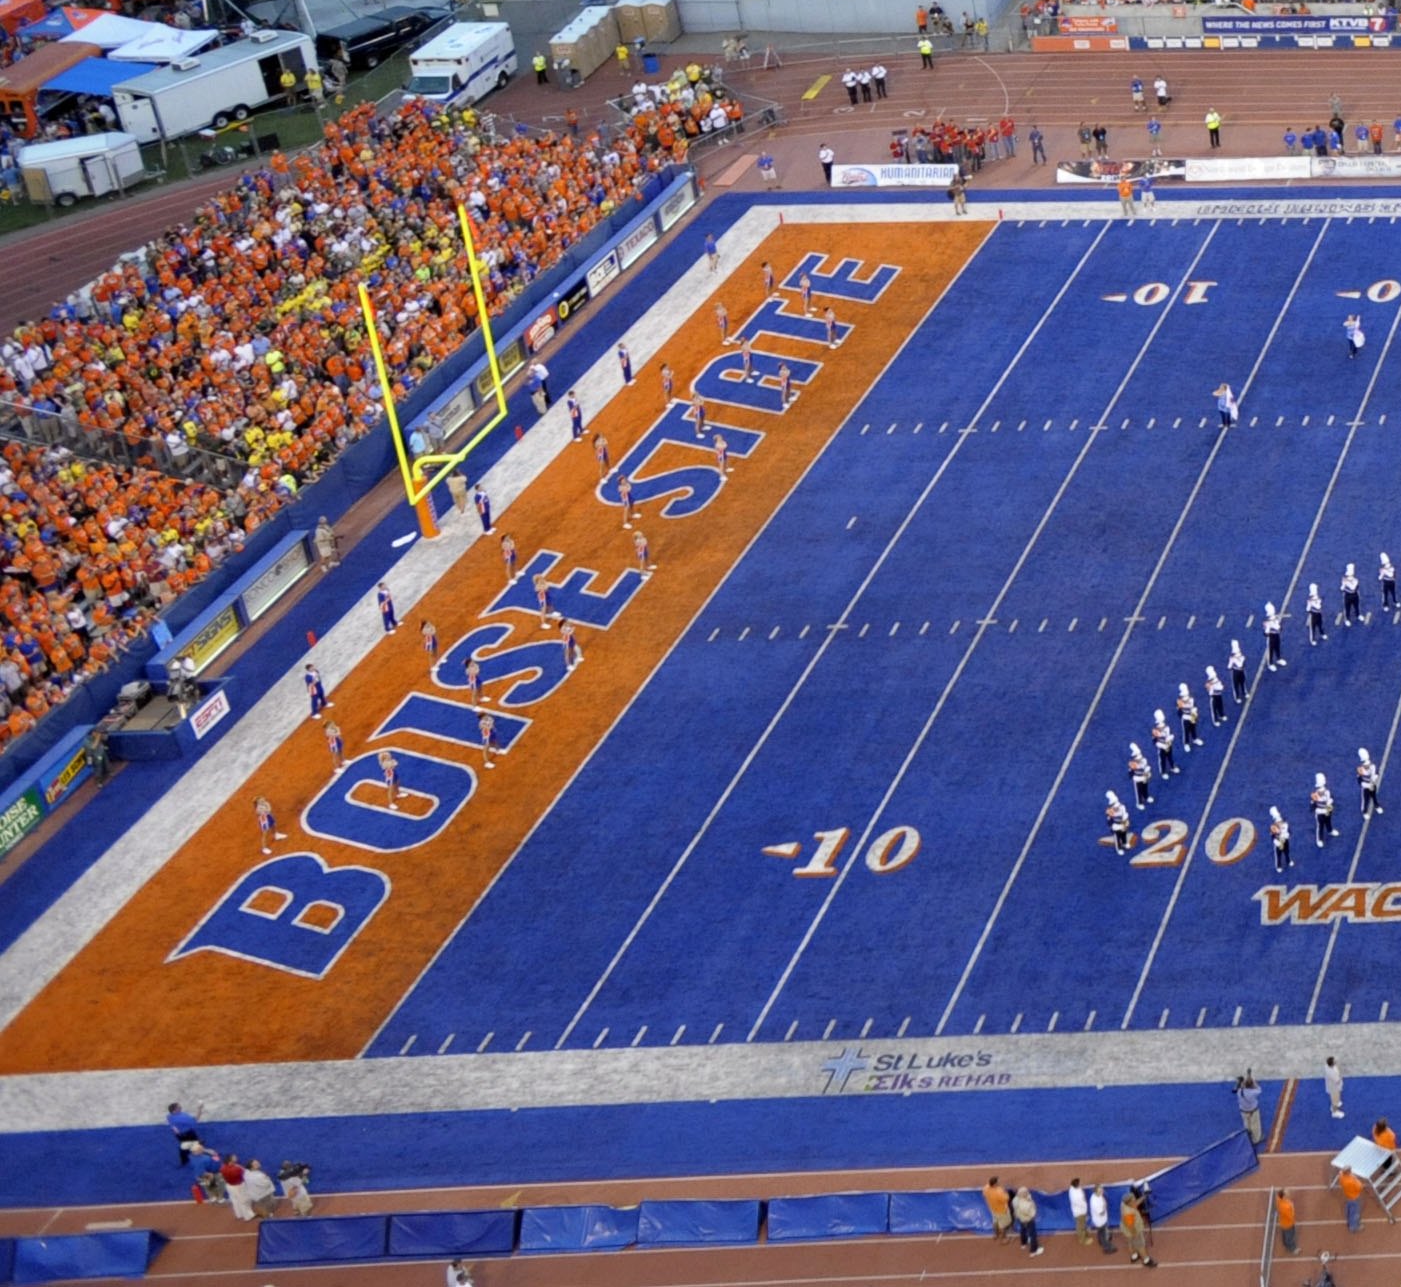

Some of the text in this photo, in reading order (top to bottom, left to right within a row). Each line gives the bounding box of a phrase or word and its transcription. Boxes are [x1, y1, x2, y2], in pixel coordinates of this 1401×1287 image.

[1206, 18, 1383, 31] WHERE THE NEWS COMES FIRST KTVB 7
[881, 167, 956, 180] HUMANITARIAN
[1134, 279, 1218, 306] 10
[596, 252, 902, 517] STATE
[195, 696, 223, 730] ESPN
[164, 550, 653, 979] BOISE
[795, 824, 922, 878] 10
[1130, 815, 1257, 869] 20
[907, 1050, 993, 1070] Luke's
[872, 1073, 1012, 1091] Elks REHAB
